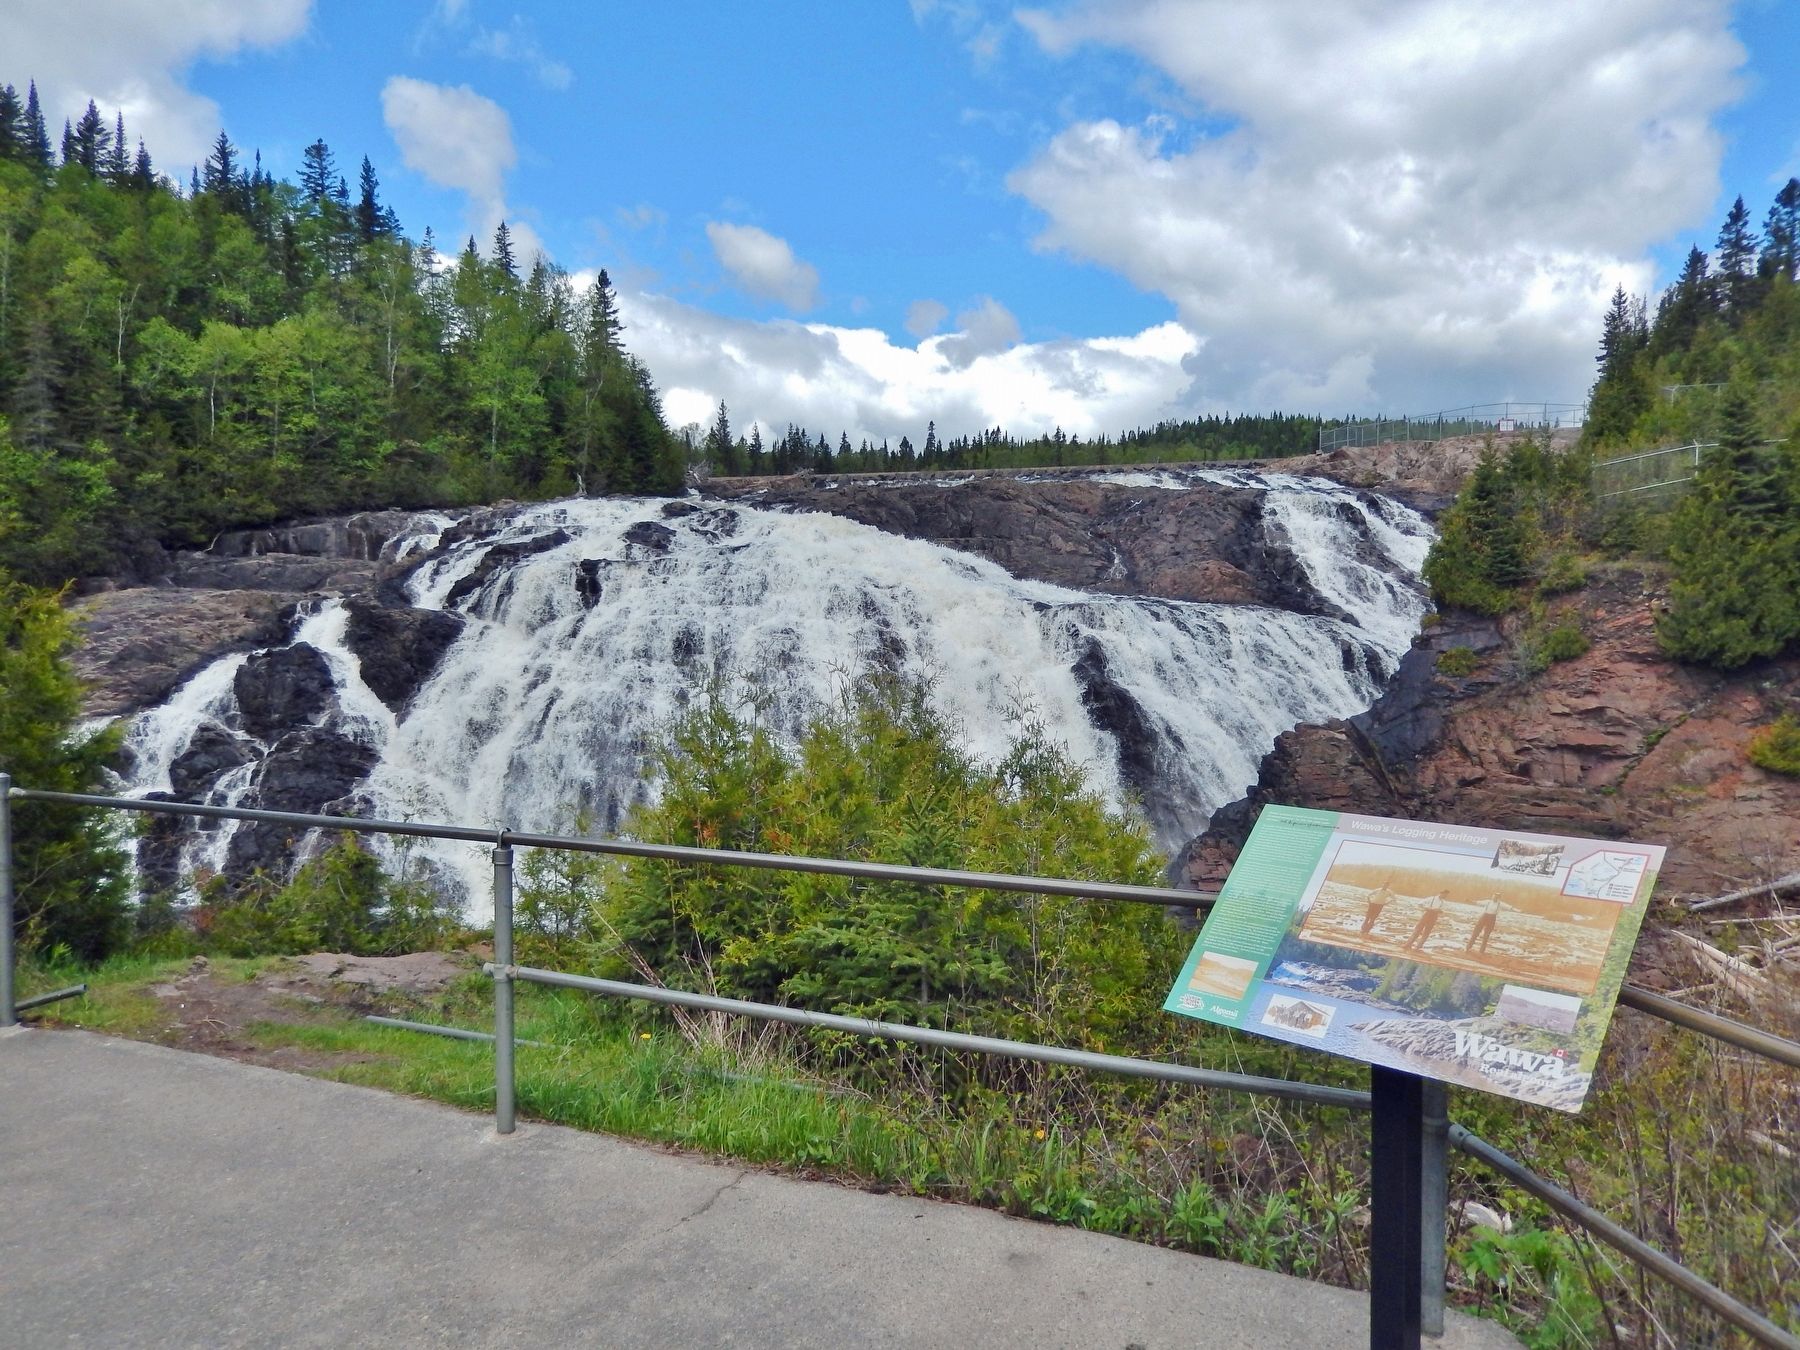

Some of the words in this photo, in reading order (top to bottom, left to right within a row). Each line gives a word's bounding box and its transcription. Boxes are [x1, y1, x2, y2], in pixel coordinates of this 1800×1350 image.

[1351, 820, 1388, 833] Wawa's
[1392, 826, 1437, 840] Logging
[1439, 831, 1488, 845] Heritage
[1454, 1030, 1565, 1079] Wawa
